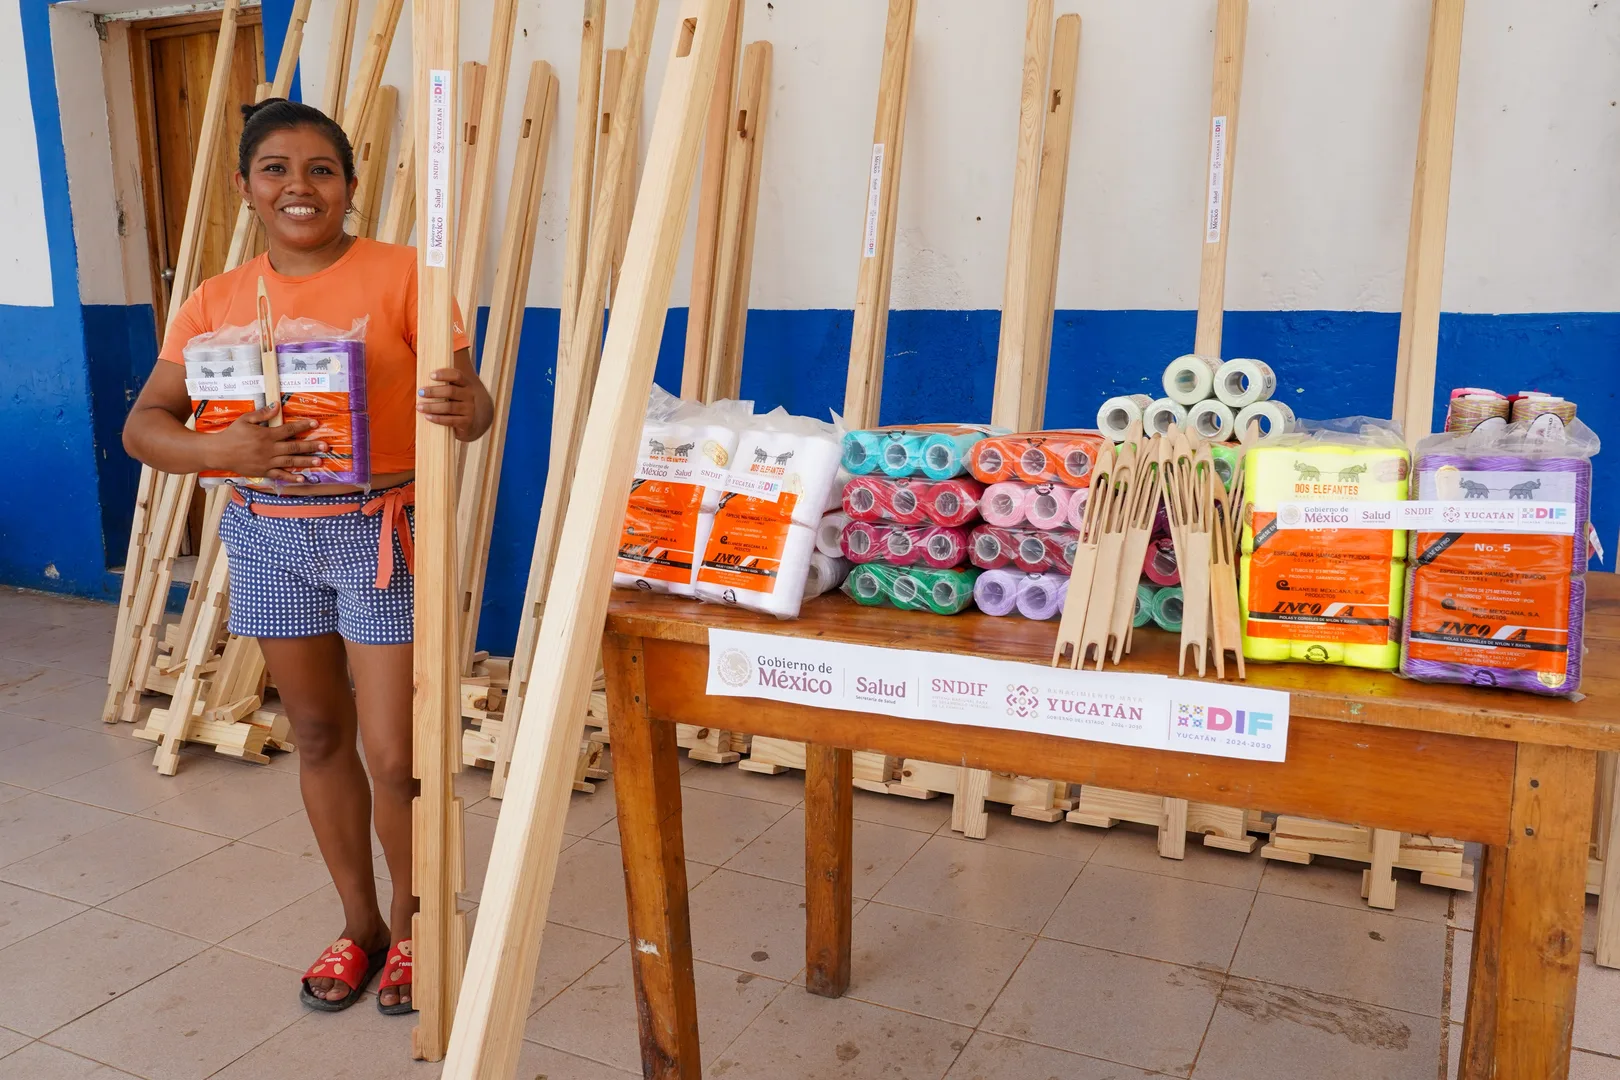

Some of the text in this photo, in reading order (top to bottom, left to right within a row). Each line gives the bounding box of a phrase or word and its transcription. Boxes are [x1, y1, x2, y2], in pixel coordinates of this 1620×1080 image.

[434, 75, 442, 94] DIF
[435, 216, 443, 248] México
[641, 467, 668, 477] México
[664, 486, 669, 494] 5
[764, 482, 778, 492] DIF
[1294, 484, 1358, 495] DOS ELEFANTES
[1304, 512, 1348, 523] México
[1362, 511, 1391, 520] Salud
[1404, 508, 1434, 516] SNDIF
[1464, 512, 1514, 520] YUCATÁN
[1536, 508, 1567, 518] DIF
[1474, 543, 1512, 552] No. 5
[1274, 550, 1298, 558] ESPECIAL
[1484, 570, 1514, 578] HAMACAS
[1272, 602, 1355, 616] INCO A
[1436, 621, 1528, 640] INCO A
[758, 655, 832, 674] Gobierno de
[758, 667, 832, 694] México
[856, 676, 906, 698] Salud
[932, 678, 988, 696] SNDIF
[1048, 688, 1115, 700] RENACIMIENTO
[1047, 698, 1143, 720] YUCATÁN
[1046, 714, 1073, 722] GOBIERNO
[1206, 706, 1273, 736] DIF
[1176, 732, 1216, 742] YUCATÁN
